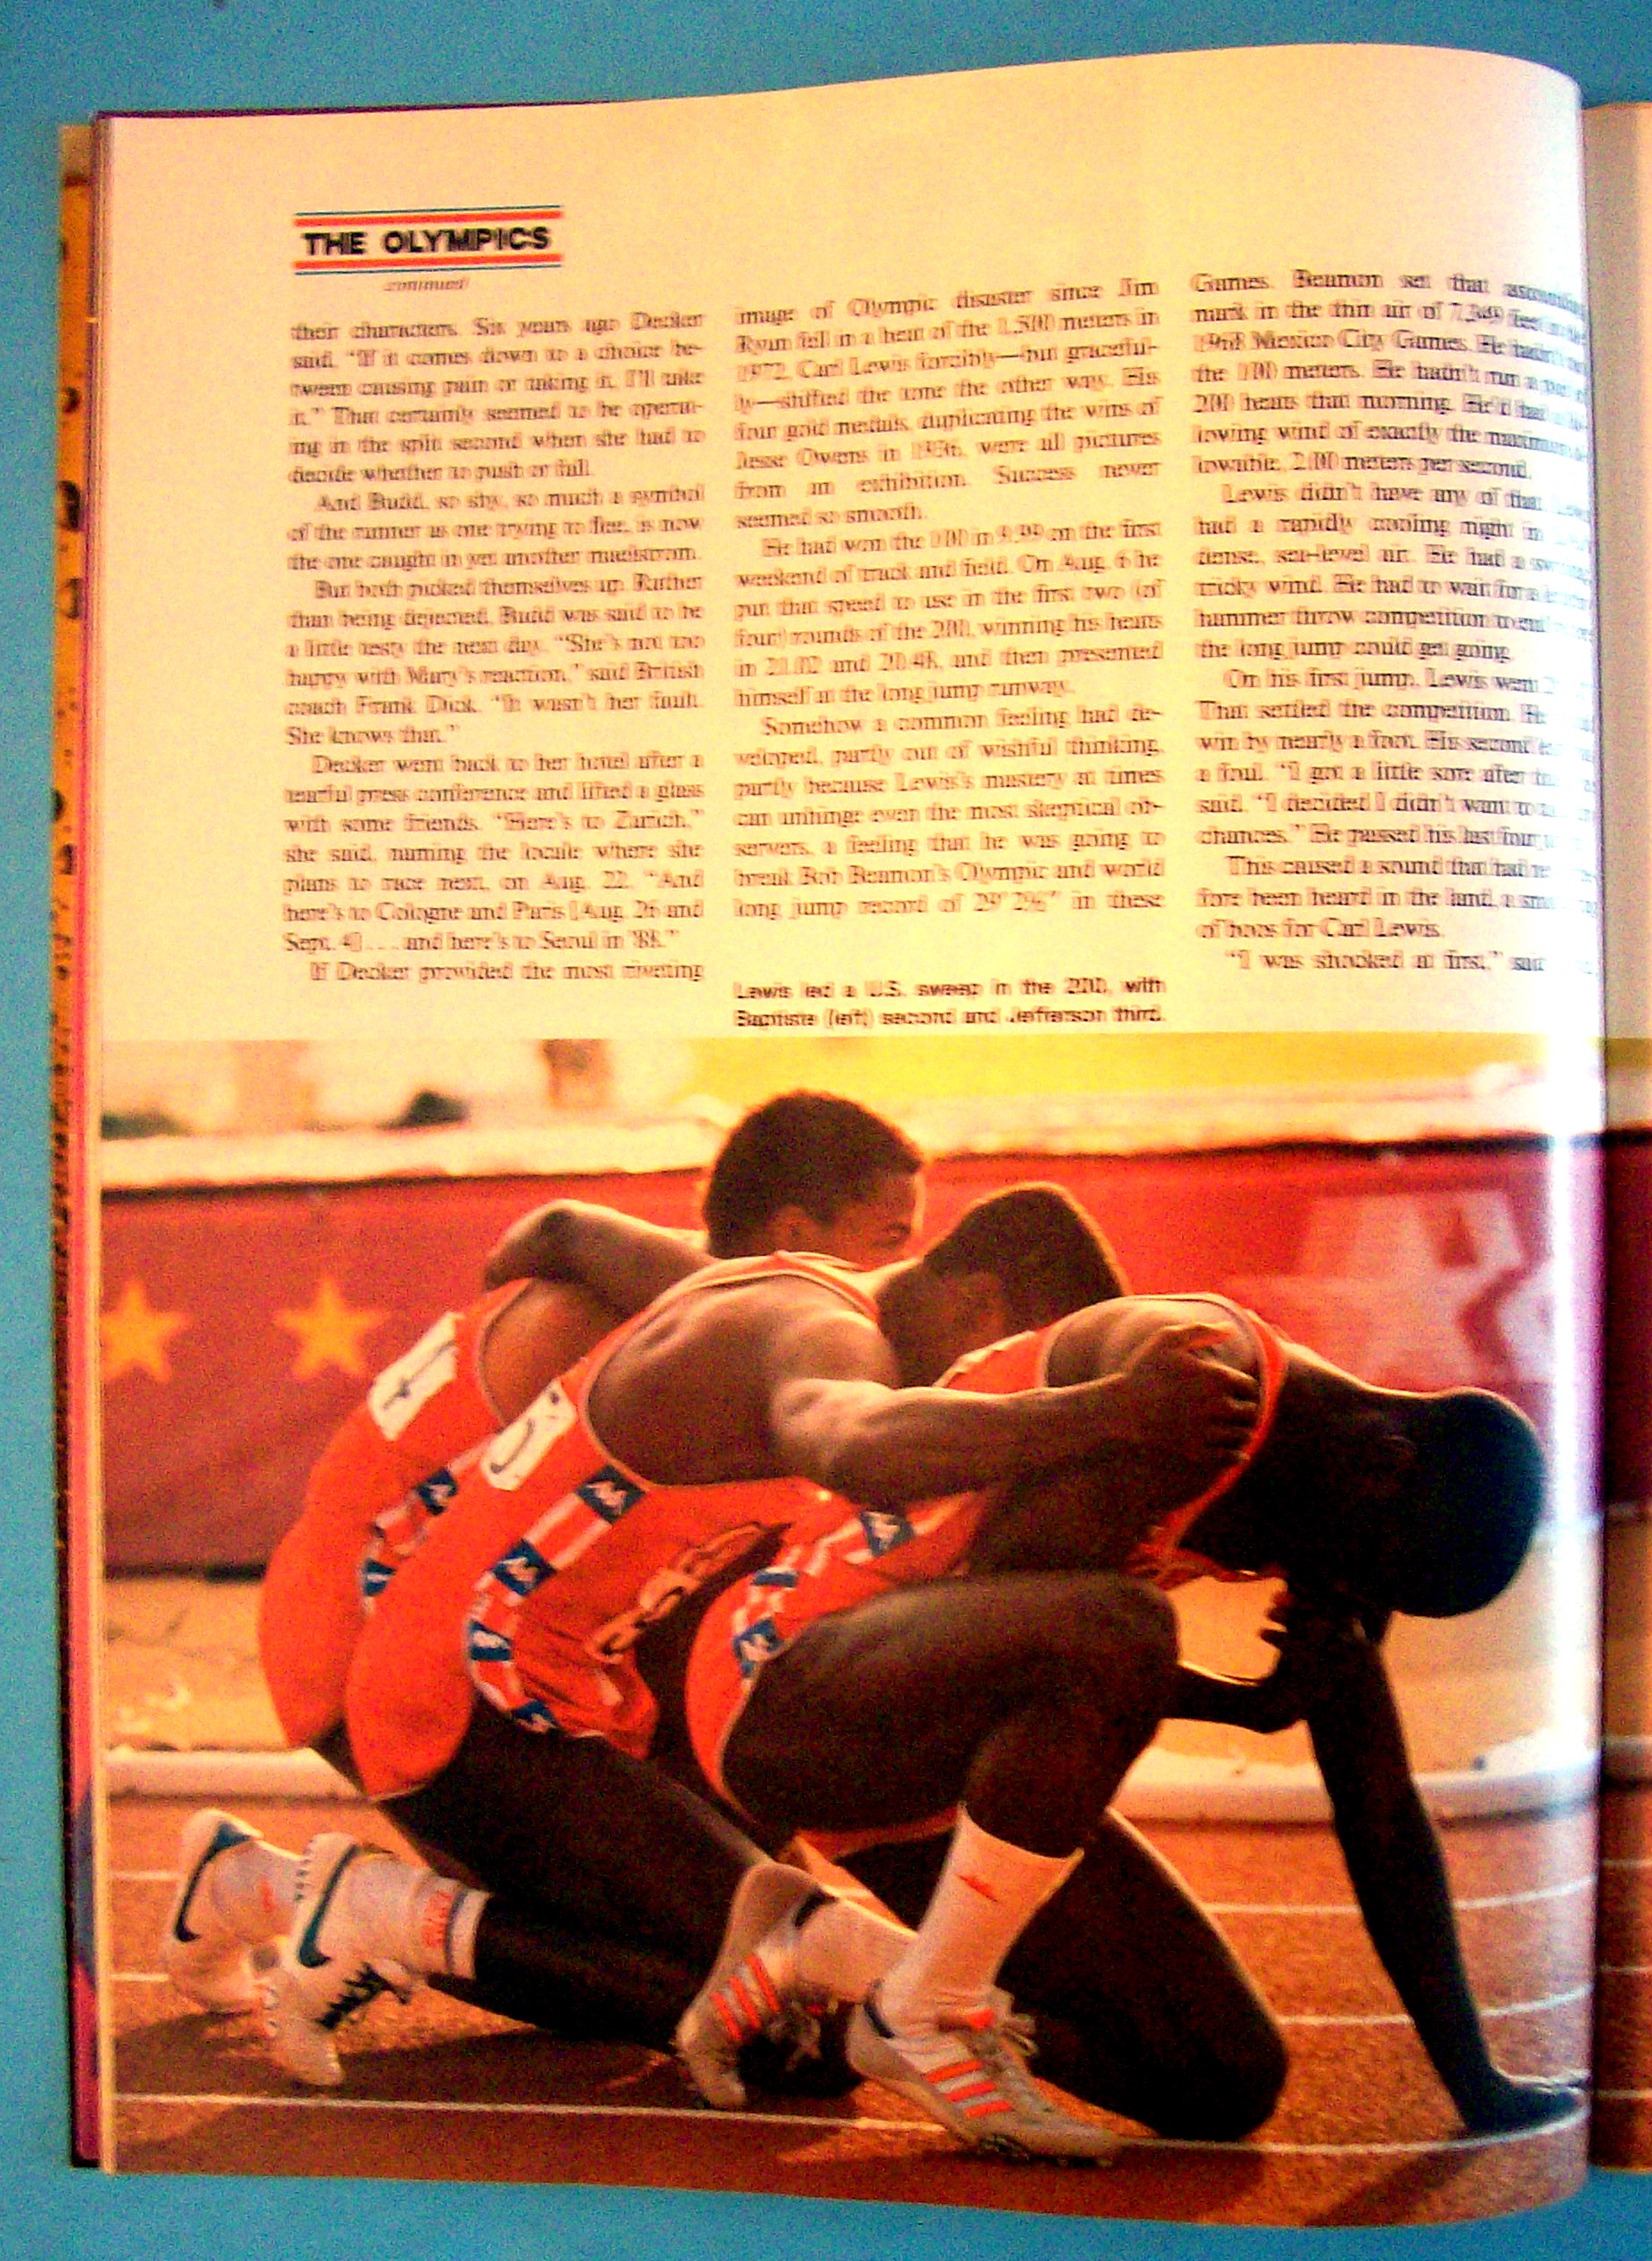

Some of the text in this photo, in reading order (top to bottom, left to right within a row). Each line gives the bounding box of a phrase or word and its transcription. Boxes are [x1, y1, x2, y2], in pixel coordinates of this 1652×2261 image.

[301, 225, 552, 257] THE OLYMPICS
[734, 980, 793, 1000] Lewis
[915, 981, 982, 1001] sweep
[733, 1007, 818, 1030] Baptiste
[880, 1006, 955, 1026] second
[1008, 1004, 1107, 1024] Jefferson
